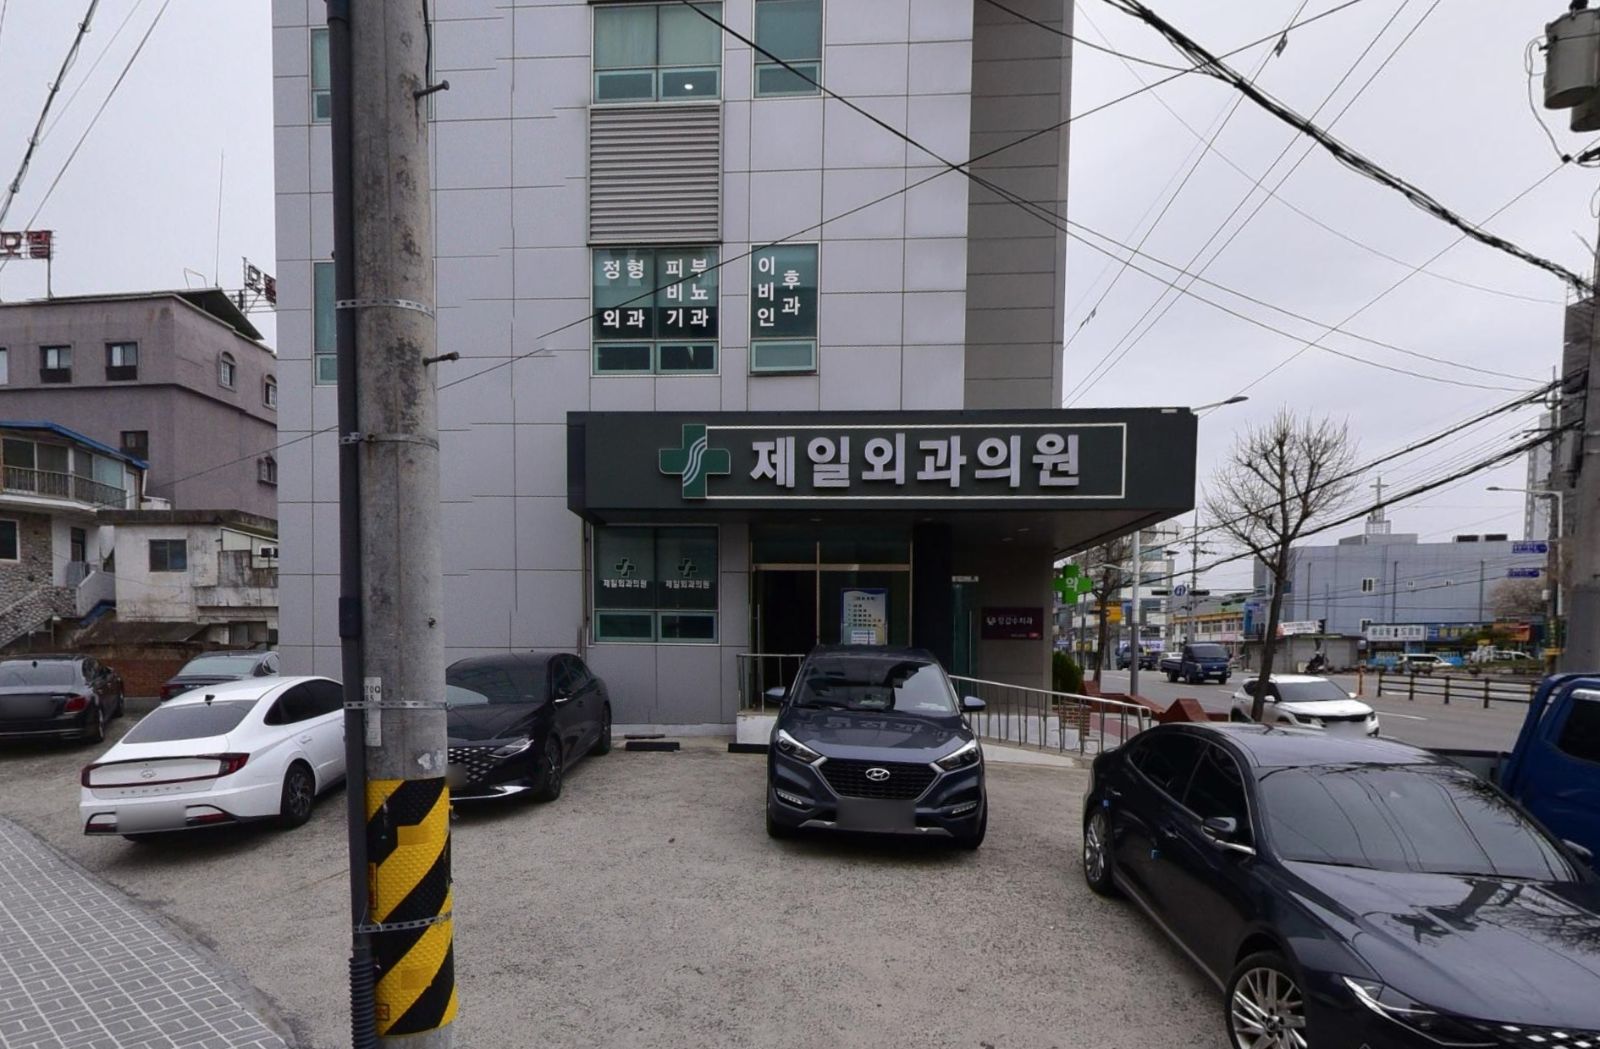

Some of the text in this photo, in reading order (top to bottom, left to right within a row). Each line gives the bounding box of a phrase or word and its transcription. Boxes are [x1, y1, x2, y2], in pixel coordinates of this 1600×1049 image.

[602, 259, 644, 279] 정형
[665, 258, 708, 278] 피부
[602, 309, 645, 328] 외과
[749, 432, 1079, 488] 제일외과의원
